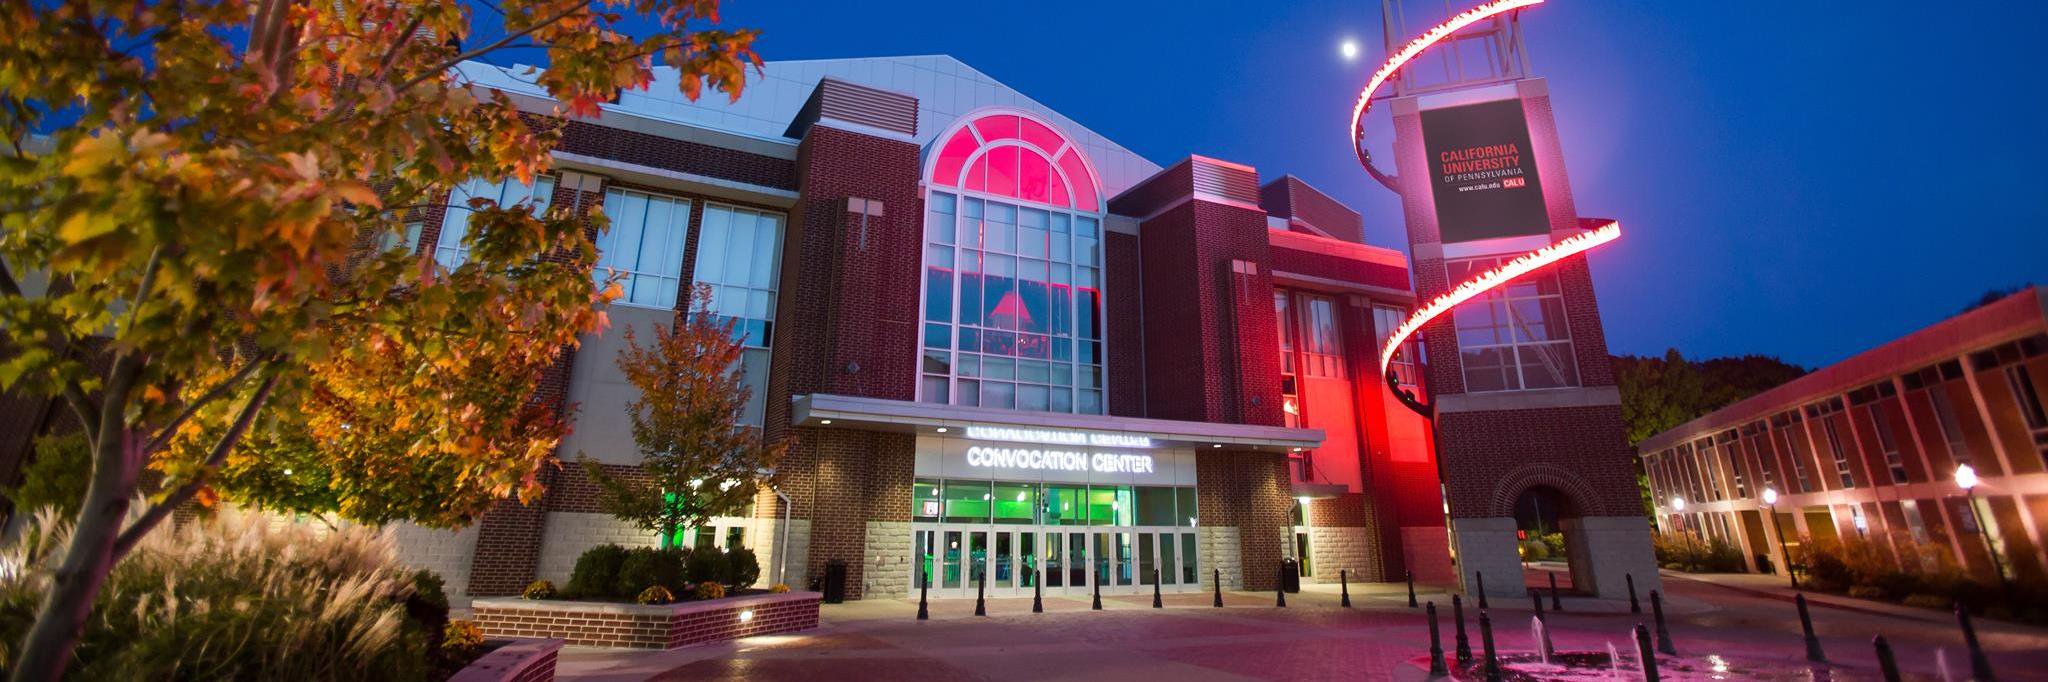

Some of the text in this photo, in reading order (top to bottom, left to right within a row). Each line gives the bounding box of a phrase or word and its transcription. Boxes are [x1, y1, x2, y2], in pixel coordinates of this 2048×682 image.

[1441, 144, 1518, 162] CALIFORNIA
[1443, 156, 1519, 174] UNIVERSITY
[1444, 167, 1524, 183] OF PENNSYLVANIA
[1458, 183, 1501, 192] www.calu.edu
[1504, 179, 1517, 187] CAL
[967, 446, 1153, 473] CONVOCATION CENTER
